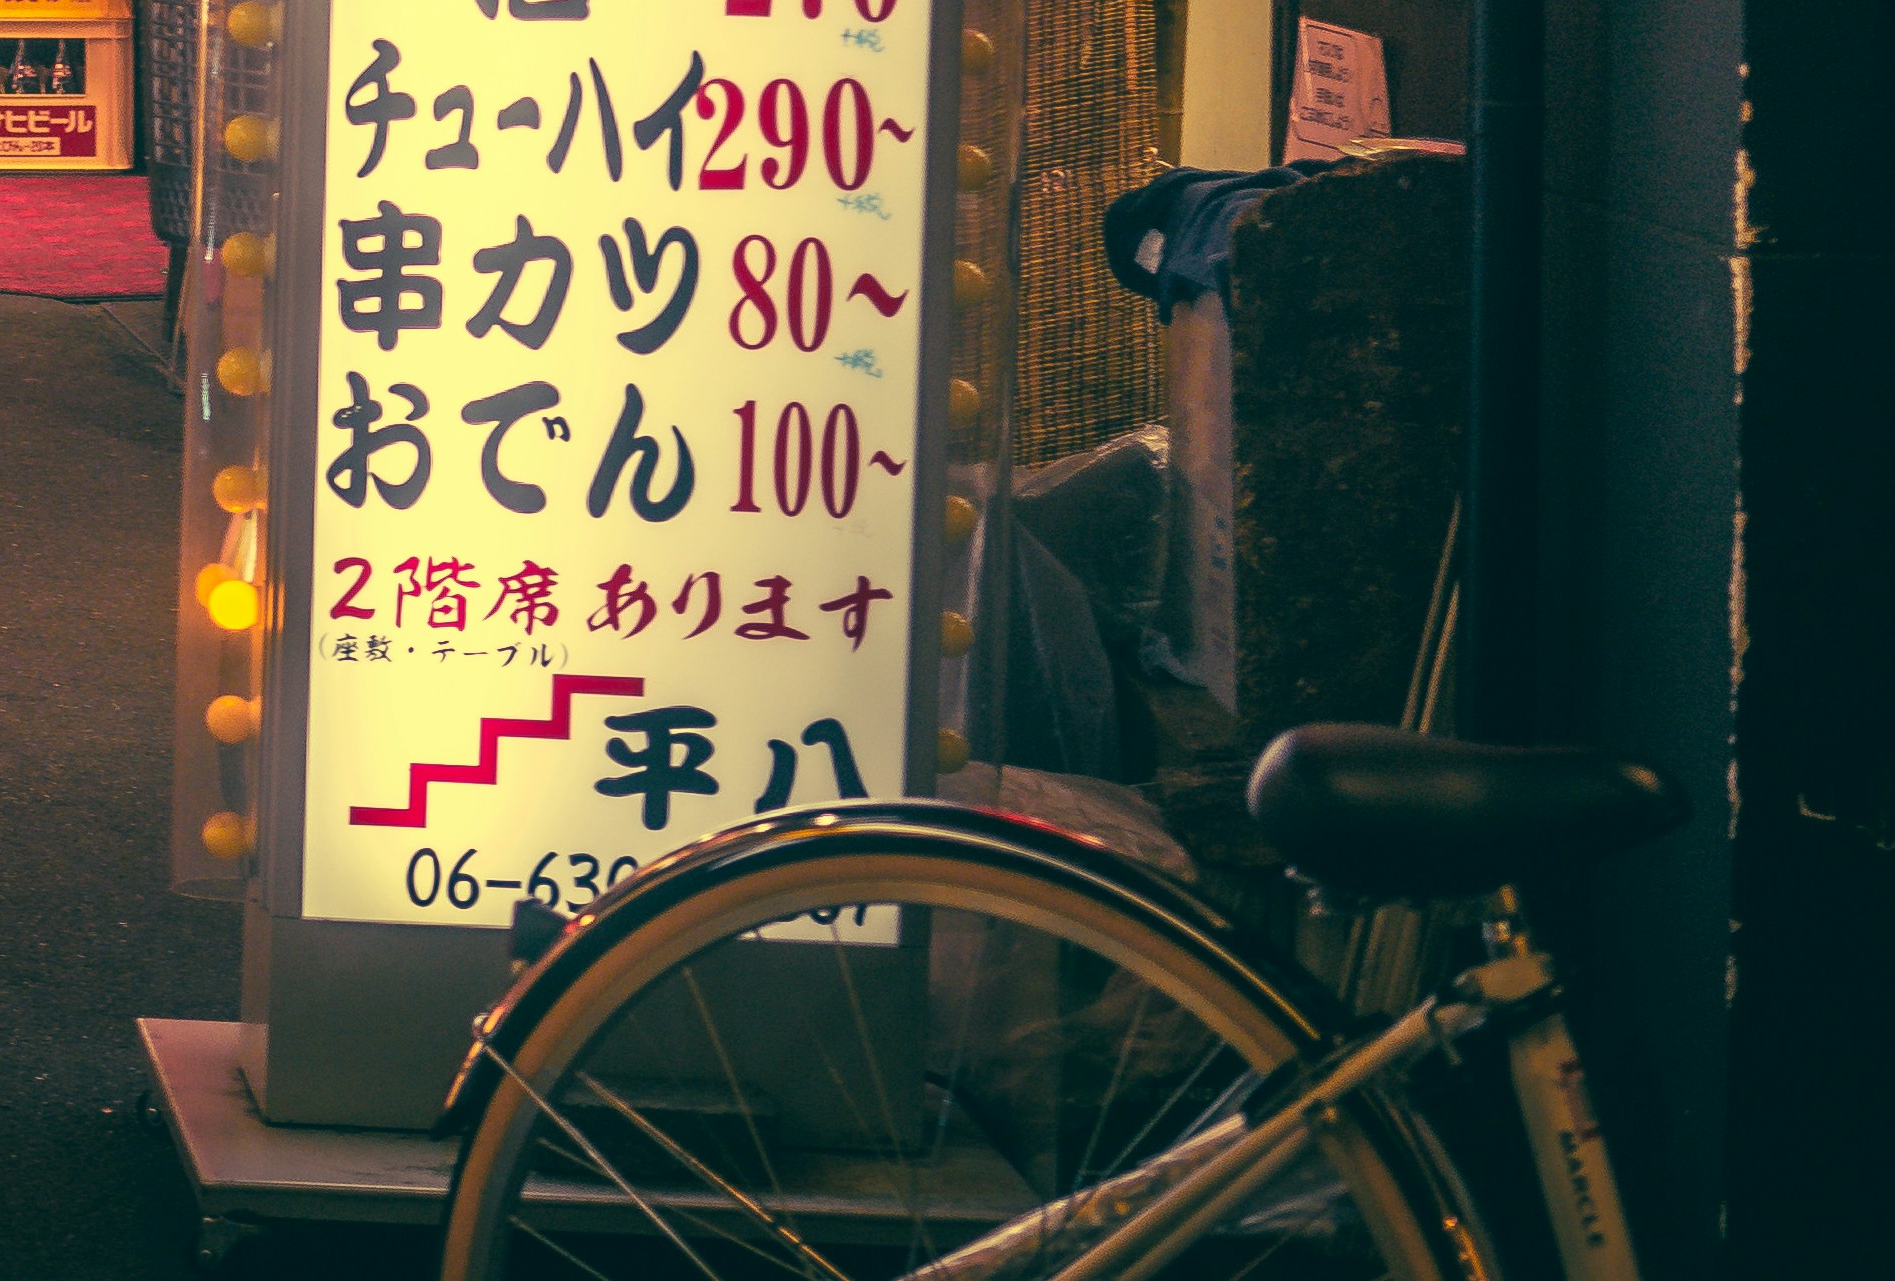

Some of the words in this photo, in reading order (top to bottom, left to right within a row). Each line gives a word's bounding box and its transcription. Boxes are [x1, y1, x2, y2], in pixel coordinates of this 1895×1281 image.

[345, 38, 706, 194] チューハイ
[335, 200, 700, 357] 串カツ
[326, 368, 697, 524] おでん
[593, 704, 870, 832] 平八
